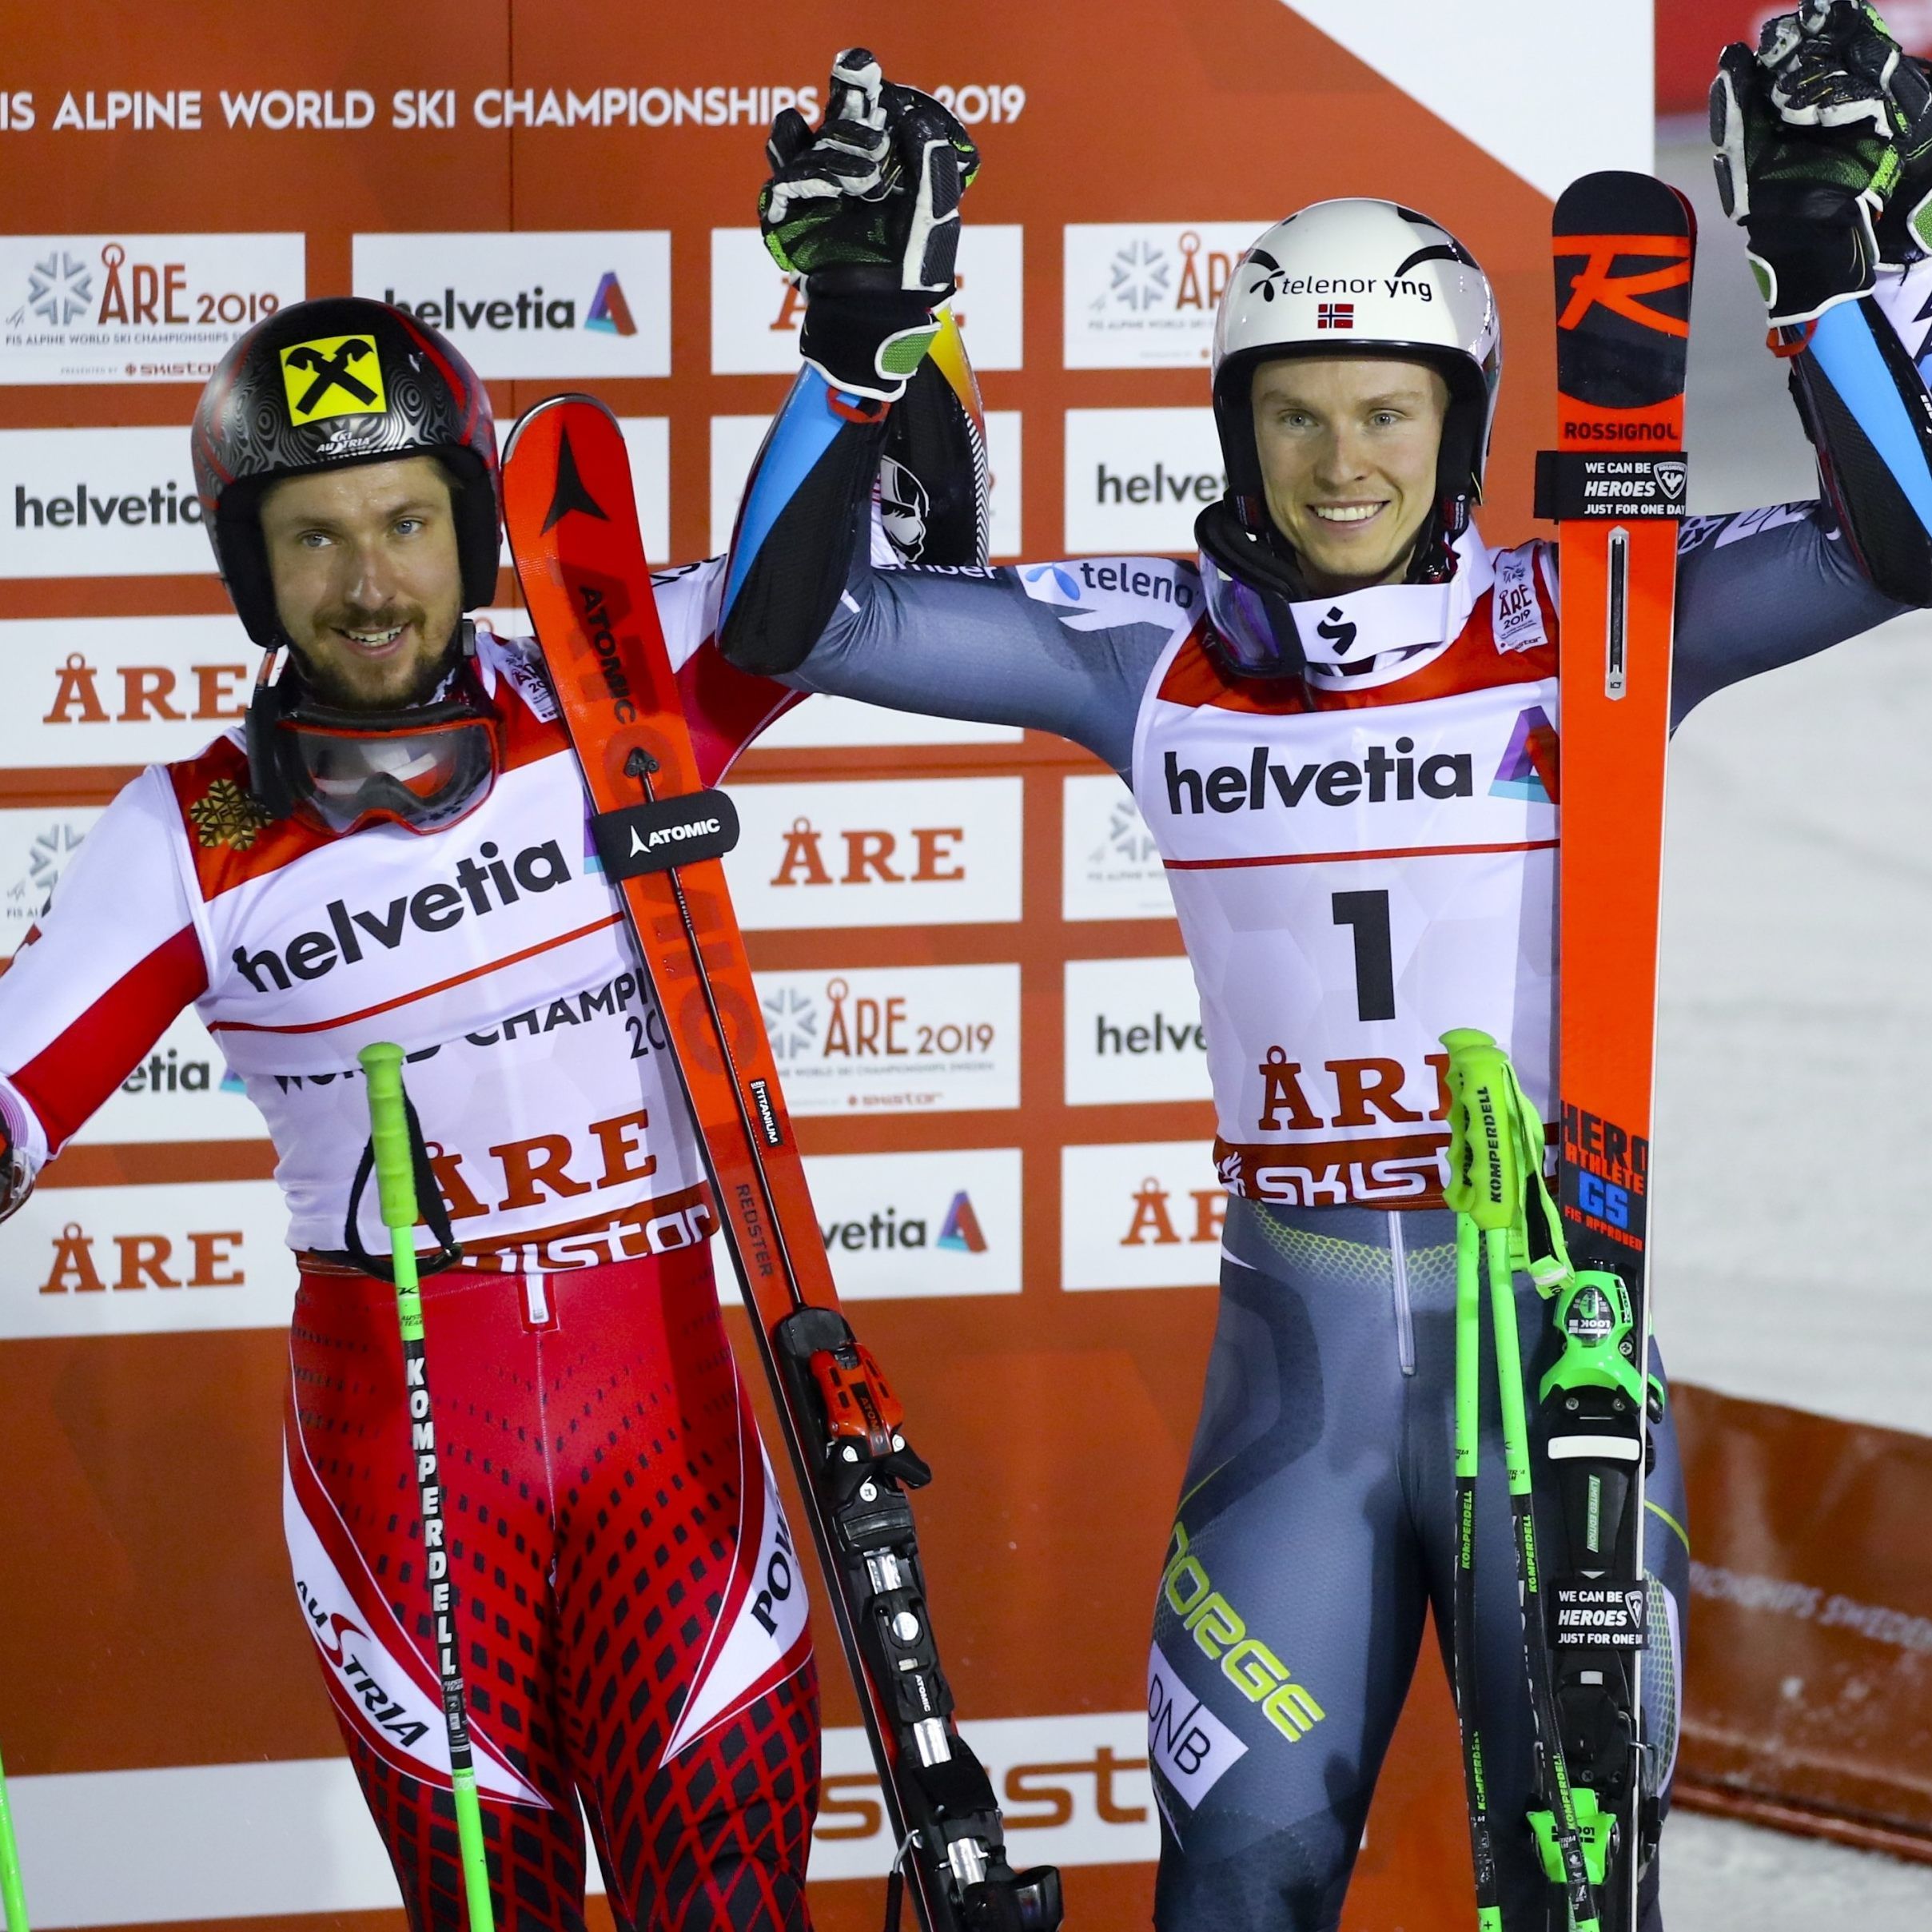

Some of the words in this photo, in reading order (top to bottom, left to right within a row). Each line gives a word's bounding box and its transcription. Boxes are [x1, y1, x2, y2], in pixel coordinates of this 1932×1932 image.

[0, 90, 35, 131] IS
[52, 90, 201, 130] ALPINE
[220, 89, 376, 130] WORLD
[392, 88, 455, 129] SKI
[473, 86, 819, 128] CHAMPIONSHIPS
[932, 84, 1026, 124] 2019
[98, 242, 189, 326] ÅRE
[197, 293, 279, 325] 2019
[1177, 230, 1245, 311] ÅR
[1281, 276, 1376, 294] telenor
[1384, 280, 1432, 302] yng
[26, 335, 66, 346] ALPINE
[70, 334, 110, 345] WORLD
[114, 334, 131, 345] SKI
[134, 333, 229, 345] CHAMPIONSHIPS
[1564, 421, 1679, 440] ROSSIGNOL
[1097, 463, 1227, 504] helve
[1583, 480, 1656, 497] HEROES
[1585, 462, 1606, 474] WE
[1607, 461, 1633, 474] CAN
[1635, 462, 1651, 474] BE
[1584, 504, 1613, 515] JUST
[1615, 504, 1639, 515] FOR
[1640, 504, 1664, 515] ONE
[1080, 561, 1197, 610] teleno
[1499, 584, 1532, 620] ÅRE
[1504, 609, 1531, 630] 2019
[578, 585, 637, 725] ATOMIC
[42, 651, 248, 723] ÅRE
[1165, 736, 1474, 815] helvetia
[647, 816, 721, 849] ATOMIC
[770, 816, 965, 886] ÅRE
[233, 840, 572, 994] helvetia
[1332, 889, 1396, 1022] 1
[823, 977, 908, 1058] ÅRE
[917, 1023, 994, 1055] 2019
[1096, 1013, 1207, 1055] helve
[121, 1049, 210, 1093] etia
[755, 1086, 779, 1144] TITANIUM
[1477, 1086, 1502, 1204] KOMPERDELL
[1564, 1141, 1644, 1197] ATHLETE
[1119, 1177, 1225, 1245] ÅR
[1578, 1169, 1629, 1229] GS
[734, 1183, 774, 1277] REDSTER
[820, 1206, 926, 1250] vetia
[1564, 1205, 1583, 1225] FIS
[1586, 1214, 1644, 1253] APPROVED
[38, 1222, 246, 1295] ÅRE
[1580, 1320, 1611, 1328] LOOK
[406, 1357, 456, 1676] KOMPERDELL
[1461, 1490, 1473, 1570] KOMPERDELL
[1523, 1514, 1538, 1593] KOMPERDELL
[1558, 1590, 1577, 1603] WE
[1579, 1591, 1604, 1603] CAN
[1607, 1591, 1623, 1603] BE
[1558, 1609, 1628, 1627] HEROES
[1558, 1632, 1585, 1644] JUST
[1587, 1633, 1611, 1644] FOR
[1611, 1633, 1635, 1645] ONE
[297, 1580, 430, 1747] AUSTRIA
[914, 1674, 931, 1712] ATOMIC
[1149, 1674, 1211, 1775] DNB
